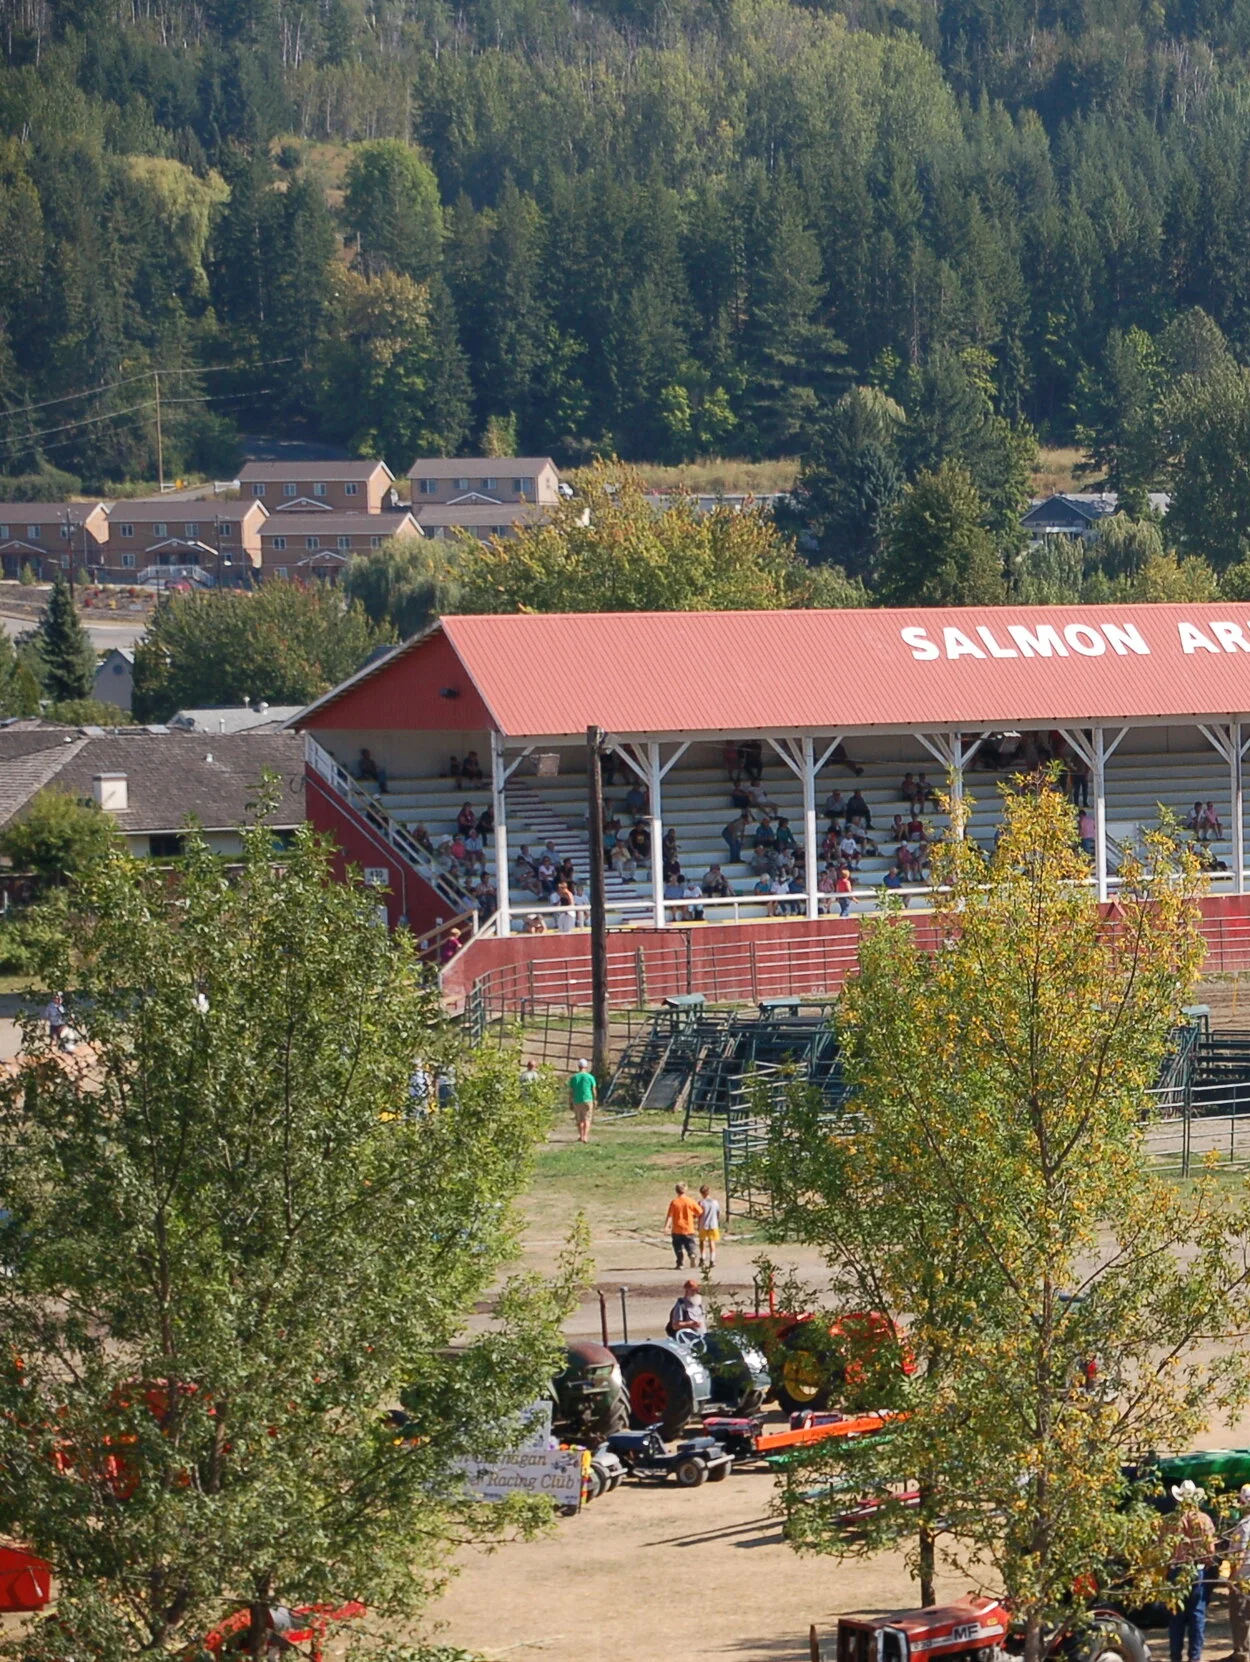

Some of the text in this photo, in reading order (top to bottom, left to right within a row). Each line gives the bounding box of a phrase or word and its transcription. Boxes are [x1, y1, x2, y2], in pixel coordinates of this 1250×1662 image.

[900, 623, 1150, 661] SALMON
[487, 1472, 537, 1491] Racing
[541, 1473, 575, 1490] Club
[954, 1624, 979, 1641] MF
